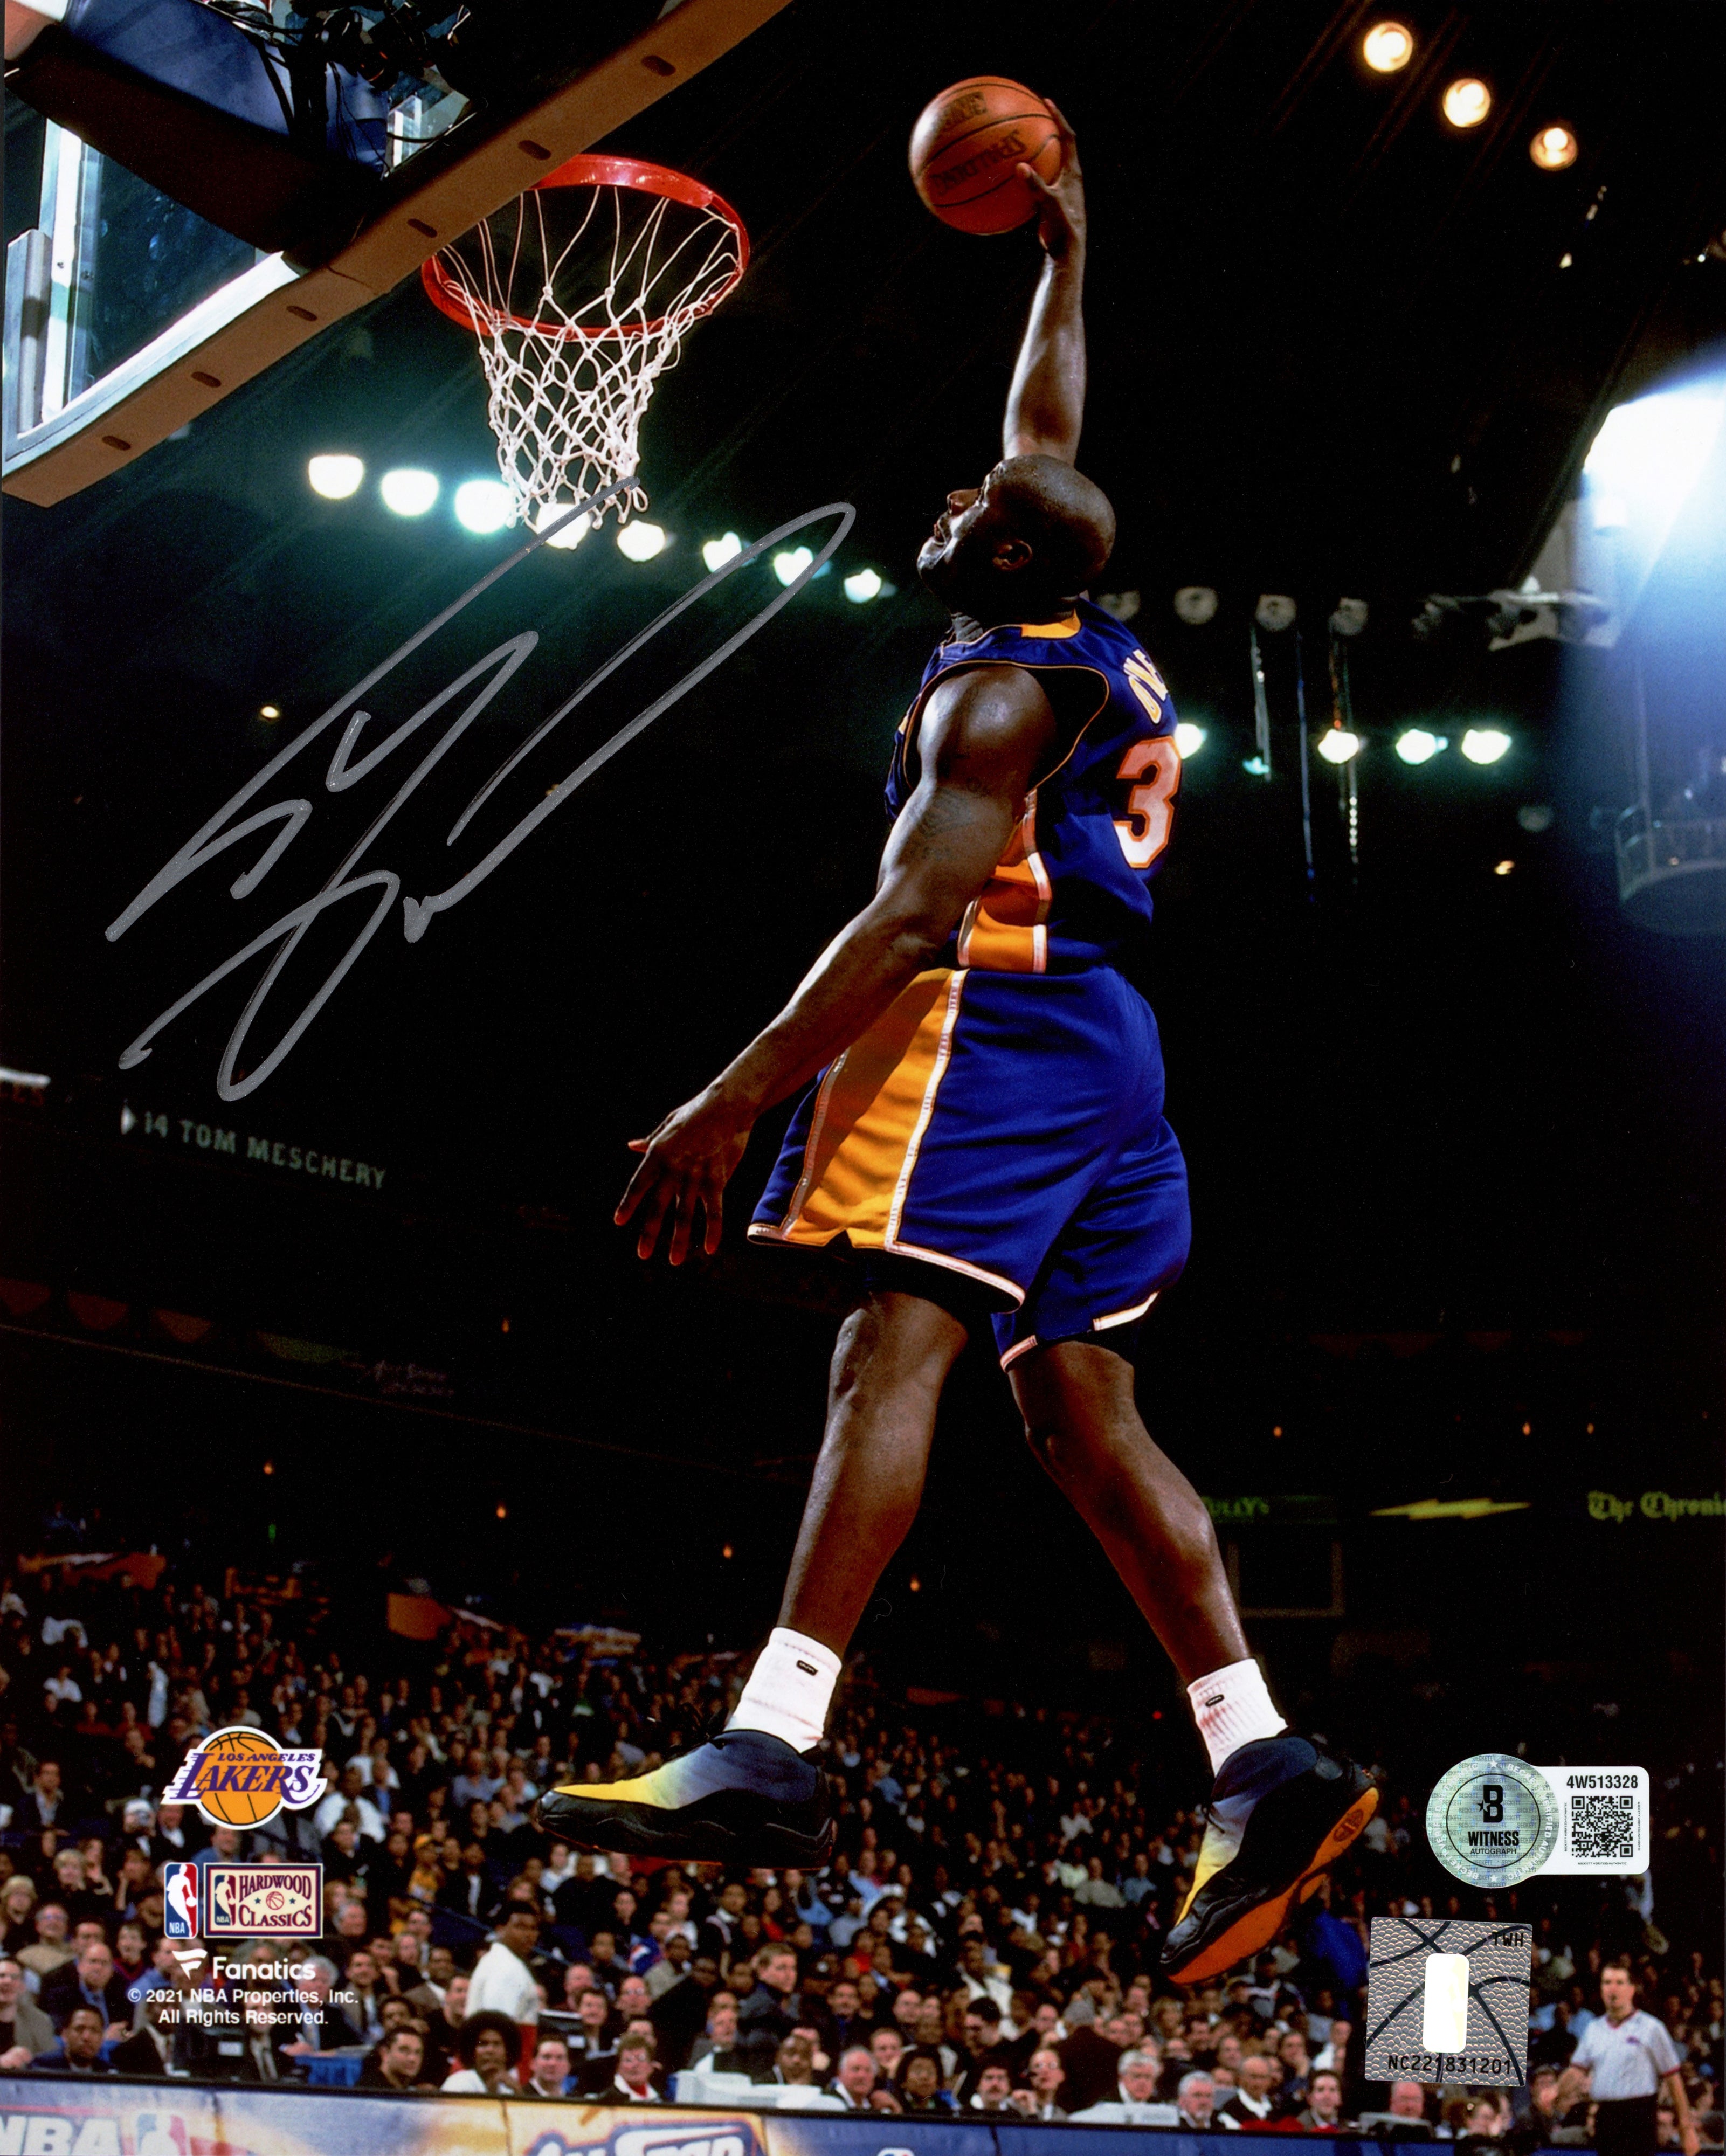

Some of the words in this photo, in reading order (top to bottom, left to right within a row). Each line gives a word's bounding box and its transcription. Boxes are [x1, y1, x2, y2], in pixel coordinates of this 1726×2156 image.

[1113, 735, 1181, 869] 3
[144, 1111, 169, 1138] 14
[179, 1118, 236, 1155] TOM
[247, 1136, 387, 1190] MESCHERY
[1566, 1775, 1638, 1789] 4W513328
[1468, 1831, 1519, 1846] WITNESS
[1388, 2055, 1511, 2075] NC221831201
